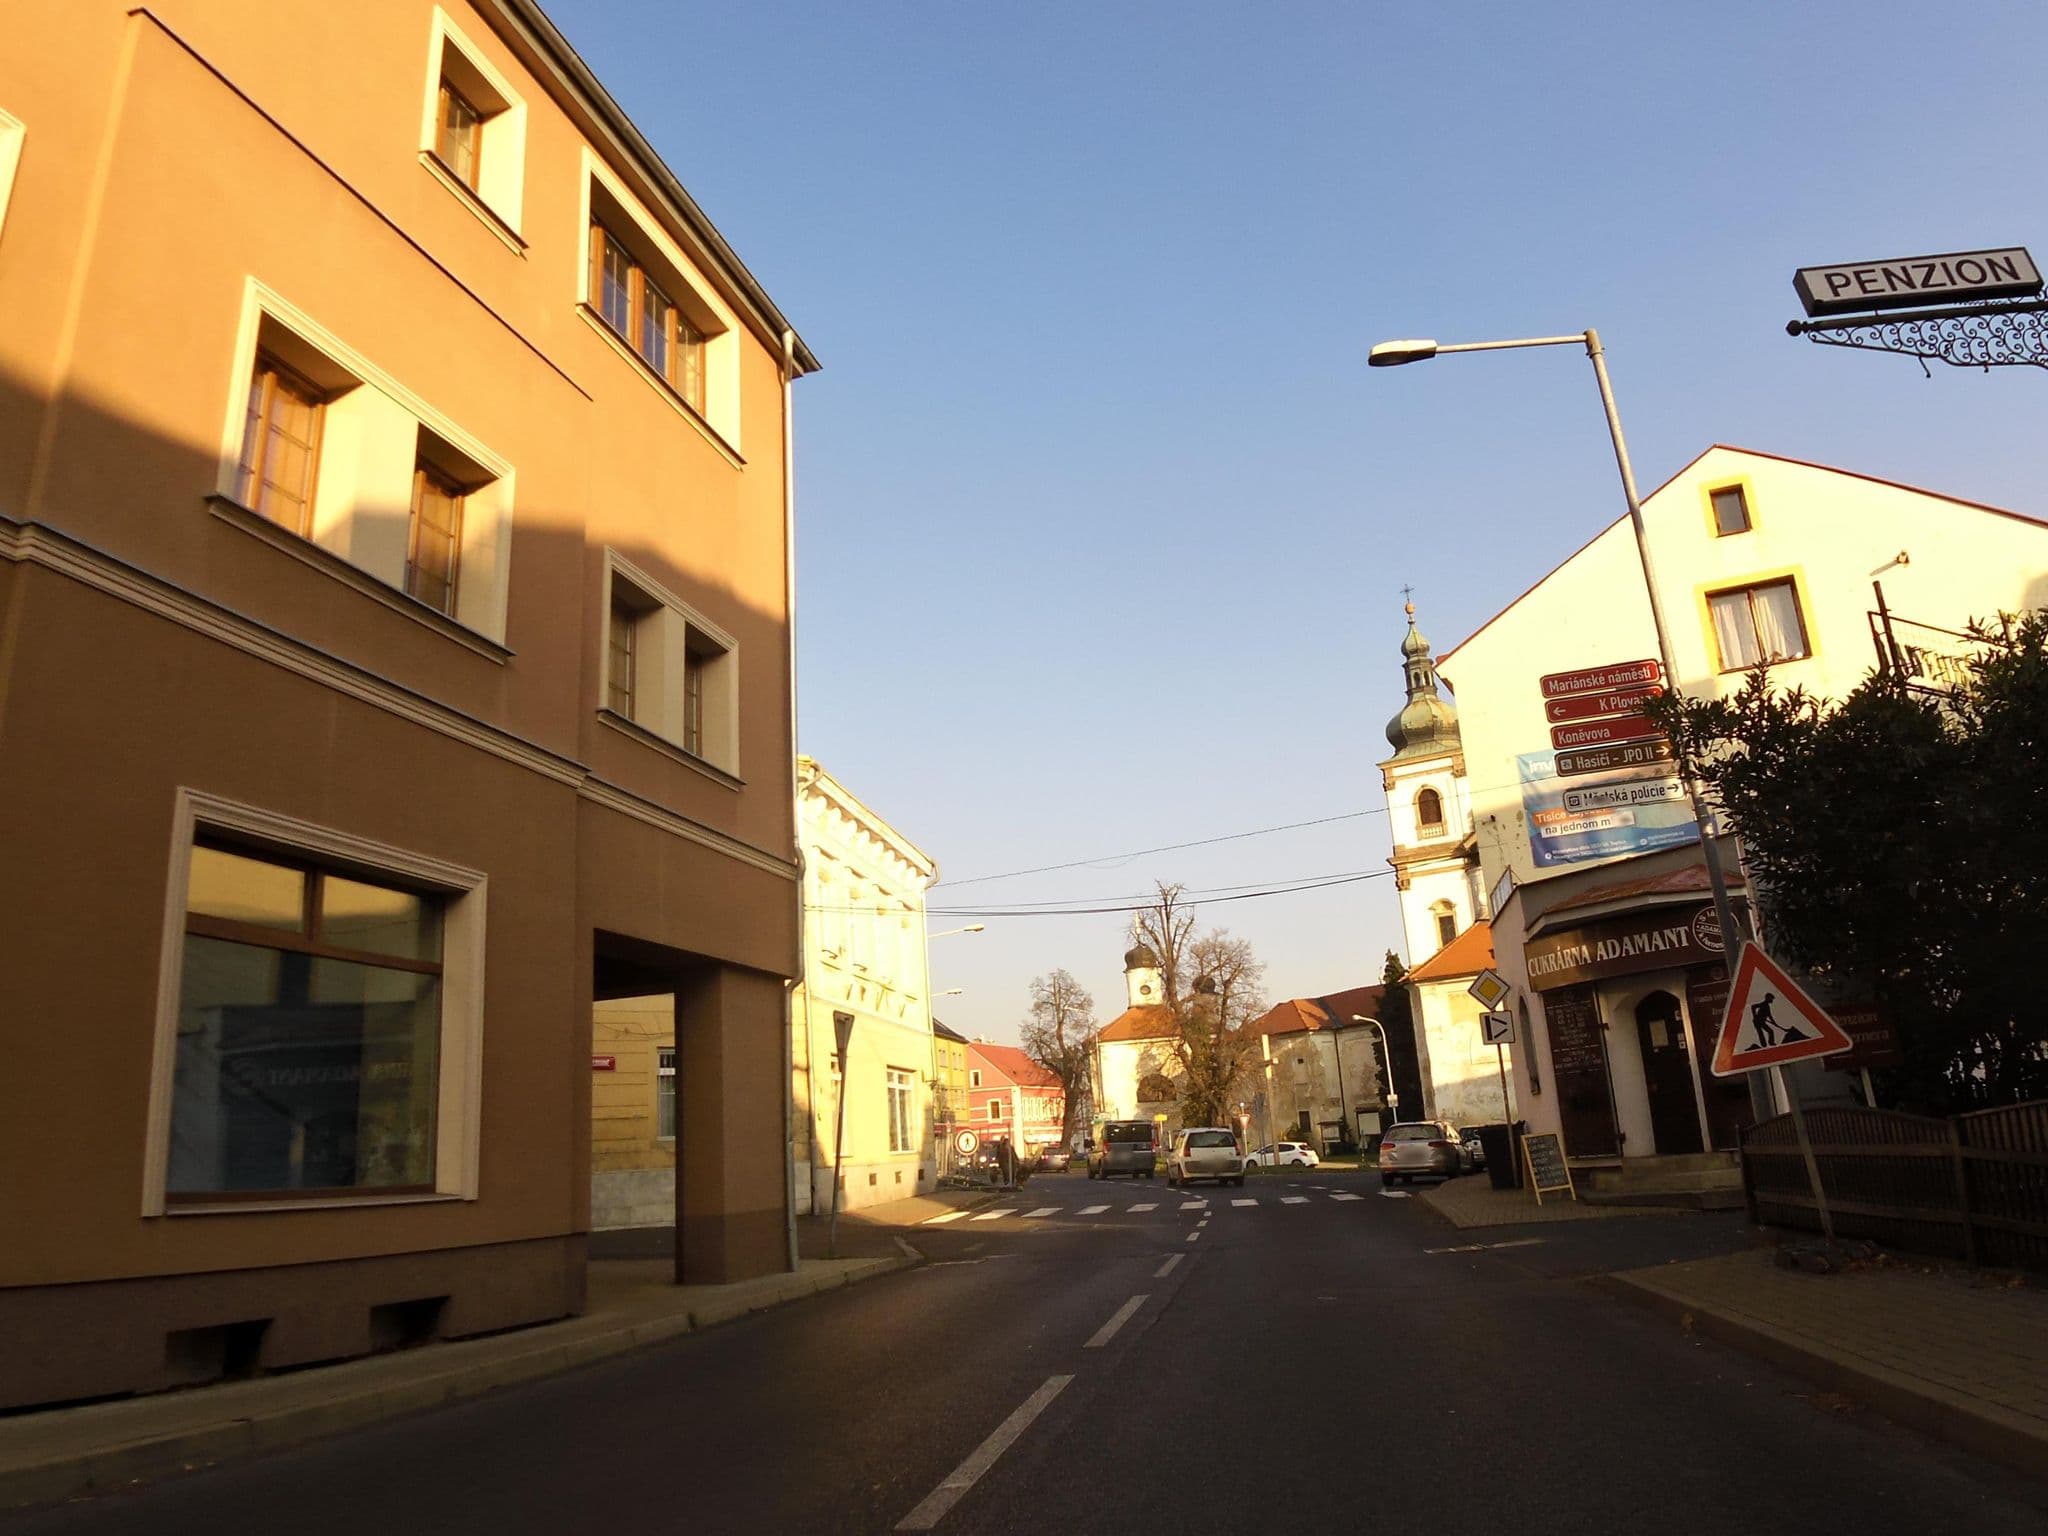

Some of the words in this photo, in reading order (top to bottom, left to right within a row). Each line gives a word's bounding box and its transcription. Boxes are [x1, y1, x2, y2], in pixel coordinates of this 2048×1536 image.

[1824, 256, 2021, 297] PENZION
[1549, 672, 1605, 693] Mariánské
[1608, 666, 1651, 683] náměstí
[1599, 698, 1608, 711] K
[1558, 727, 1611, 745] Koněvova
[1576, 753, 1610, 770] Hasiči
[1623, 748, 1646, 763] JPO
[1631, 784, 1665, 802] policie
[1545, 826, 1557, 835] na
[1560, 820, 1598, 834] jednom
[1528, 945, 1592, 977] CUKRÁRNA
[1597, 926, 1689, 961] ADAMANT
